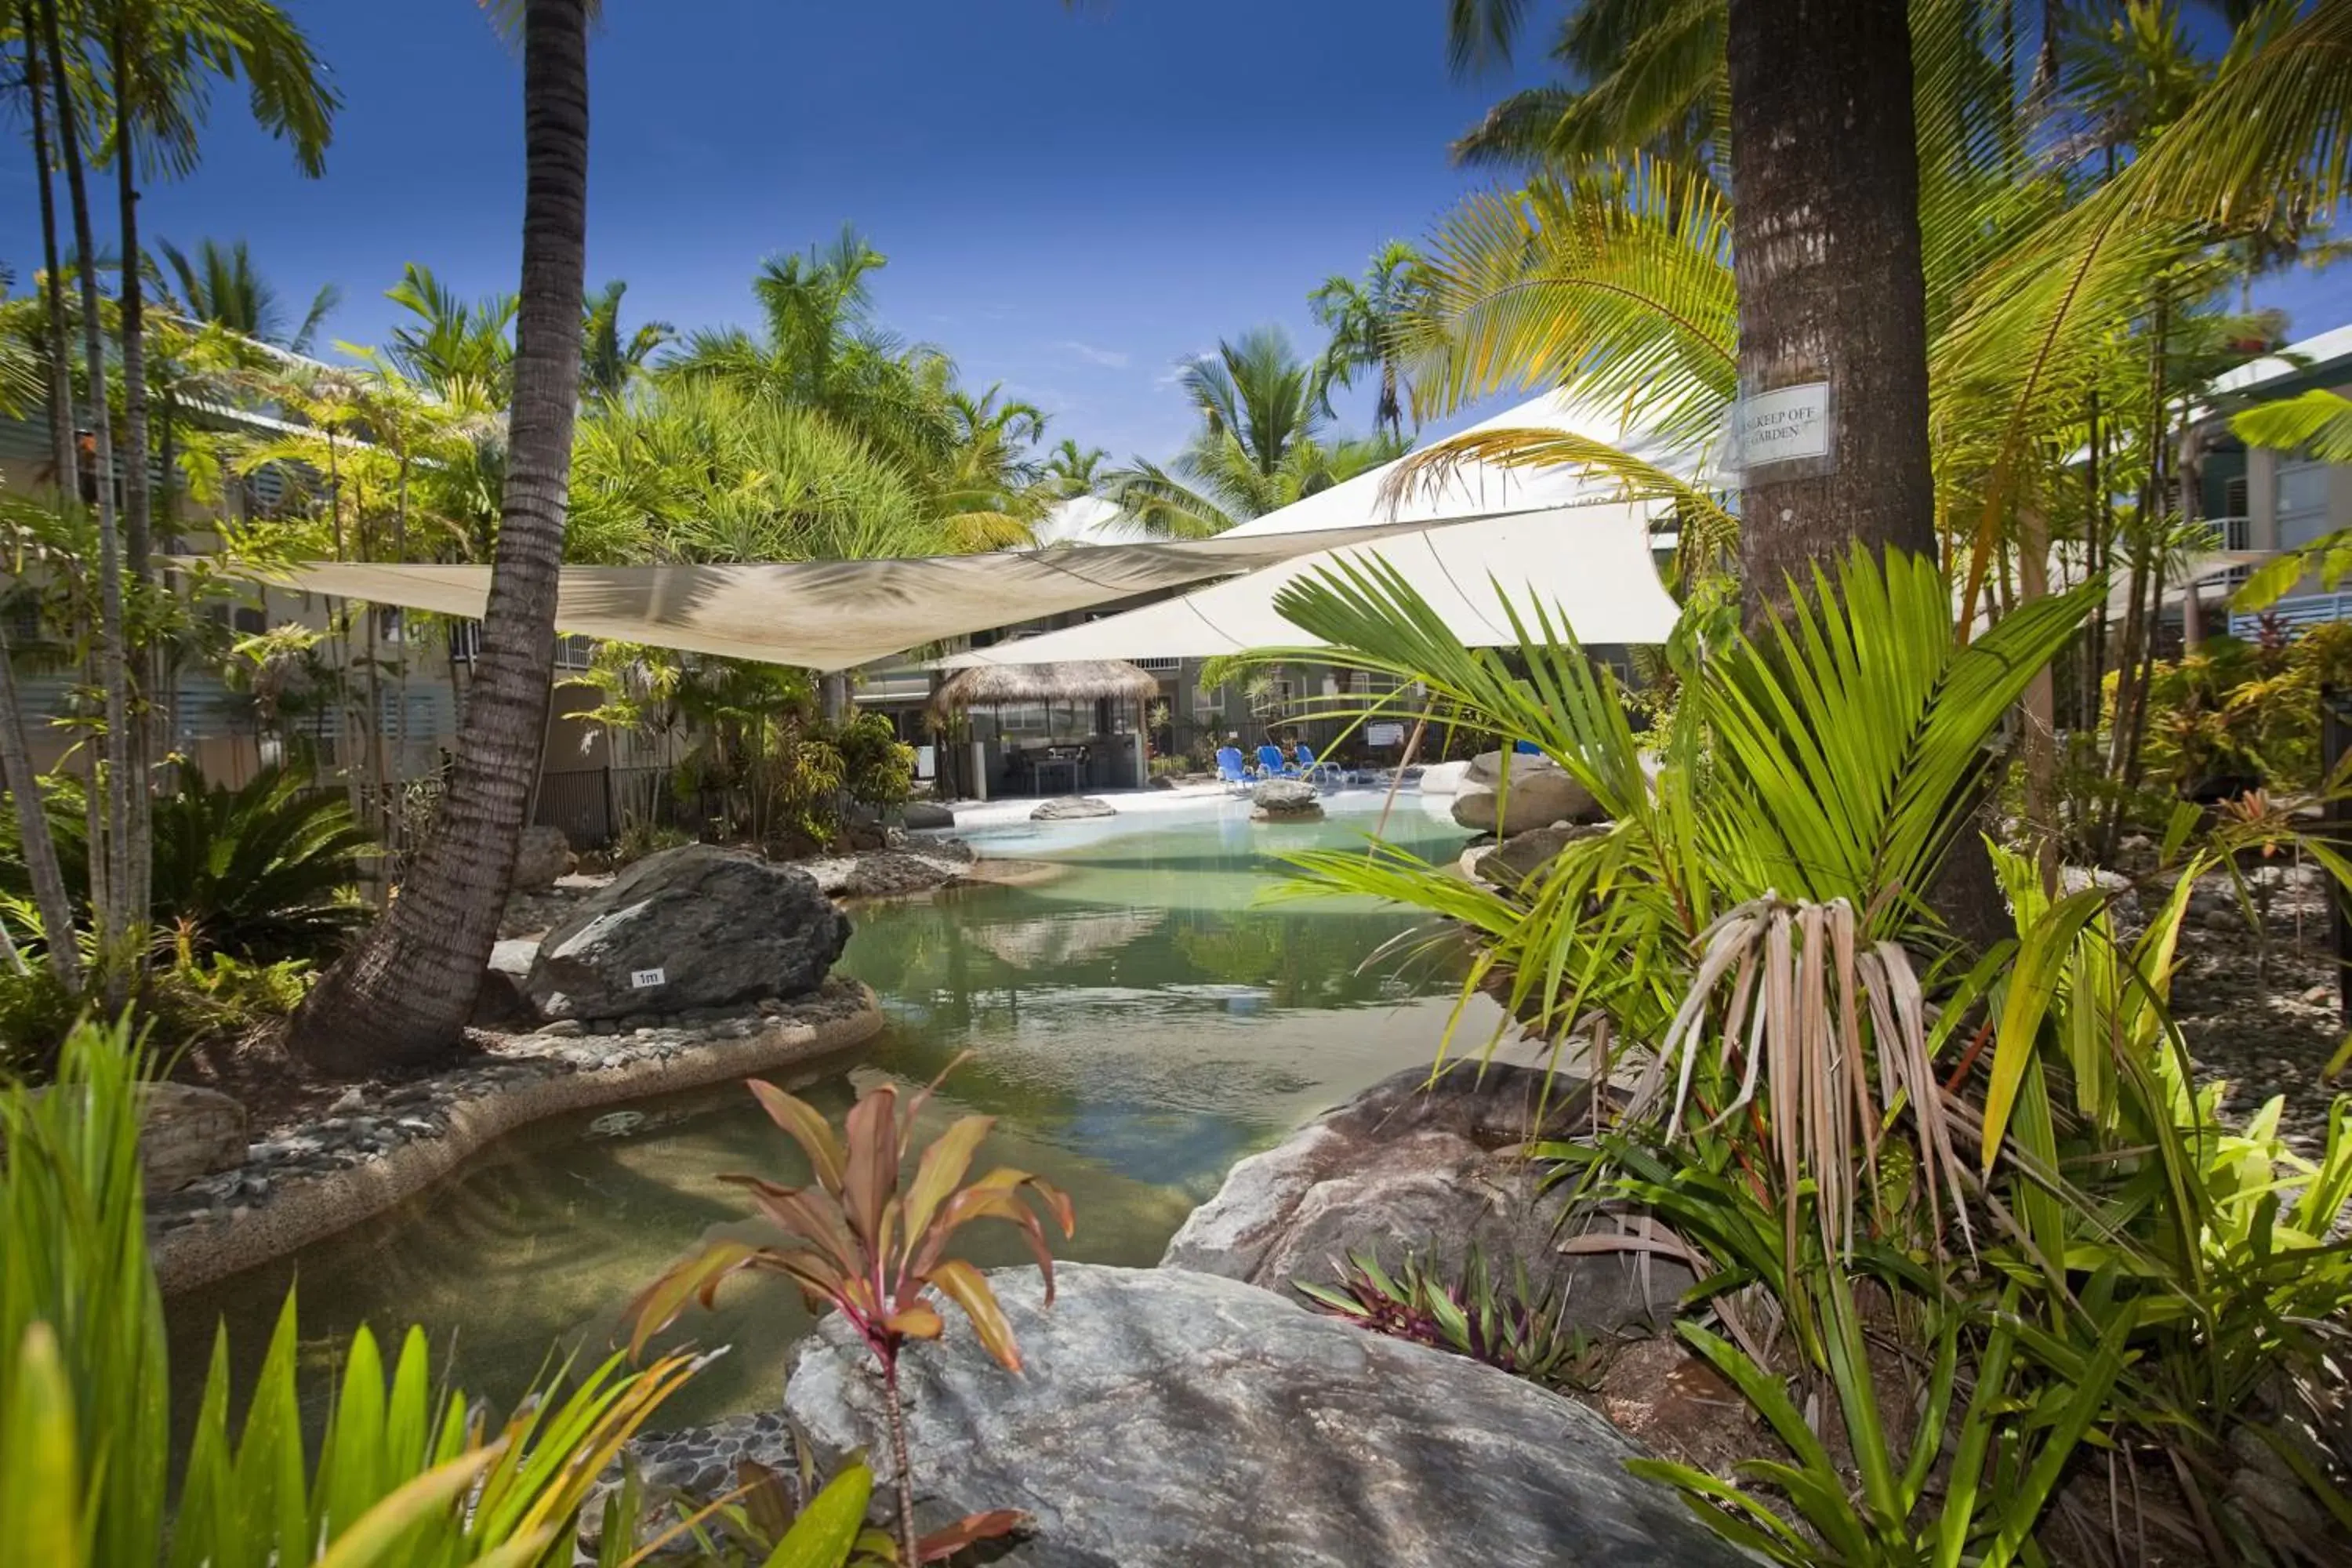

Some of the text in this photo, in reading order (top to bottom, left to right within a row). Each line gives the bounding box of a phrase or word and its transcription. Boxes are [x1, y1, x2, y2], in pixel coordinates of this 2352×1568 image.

[1757, 412, 1785, 427] KEEP
[1788, 406, 1816, 421] OFF
[1751, 425, 1798, 445] GARDEN
[640, 974, 658, 984] 1m
